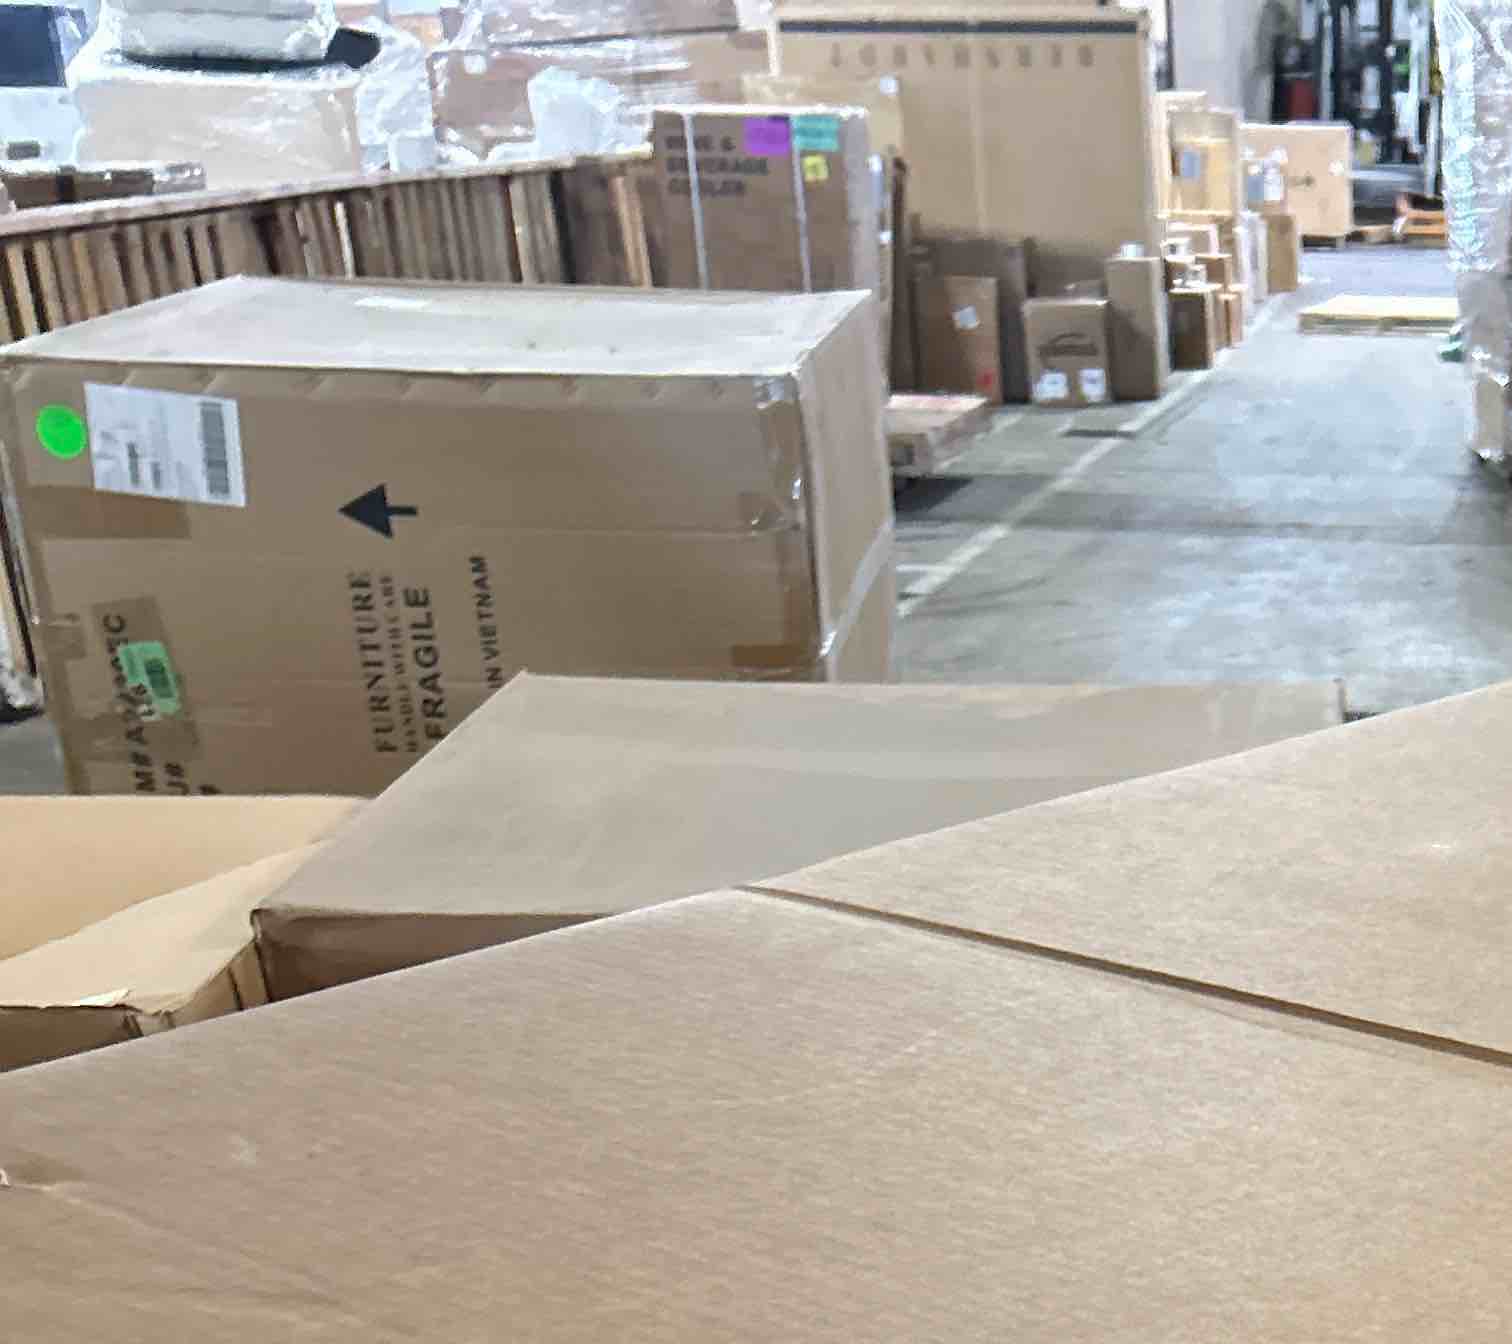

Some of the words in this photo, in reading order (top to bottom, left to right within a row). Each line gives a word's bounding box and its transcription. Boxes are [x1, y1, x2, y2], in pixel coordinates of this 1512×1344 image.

[348, 571, 399, 752] FURNITURE
[403, 587, 450, 740] FRAGILE
[469, 556, 501, 661] VIETNAM
